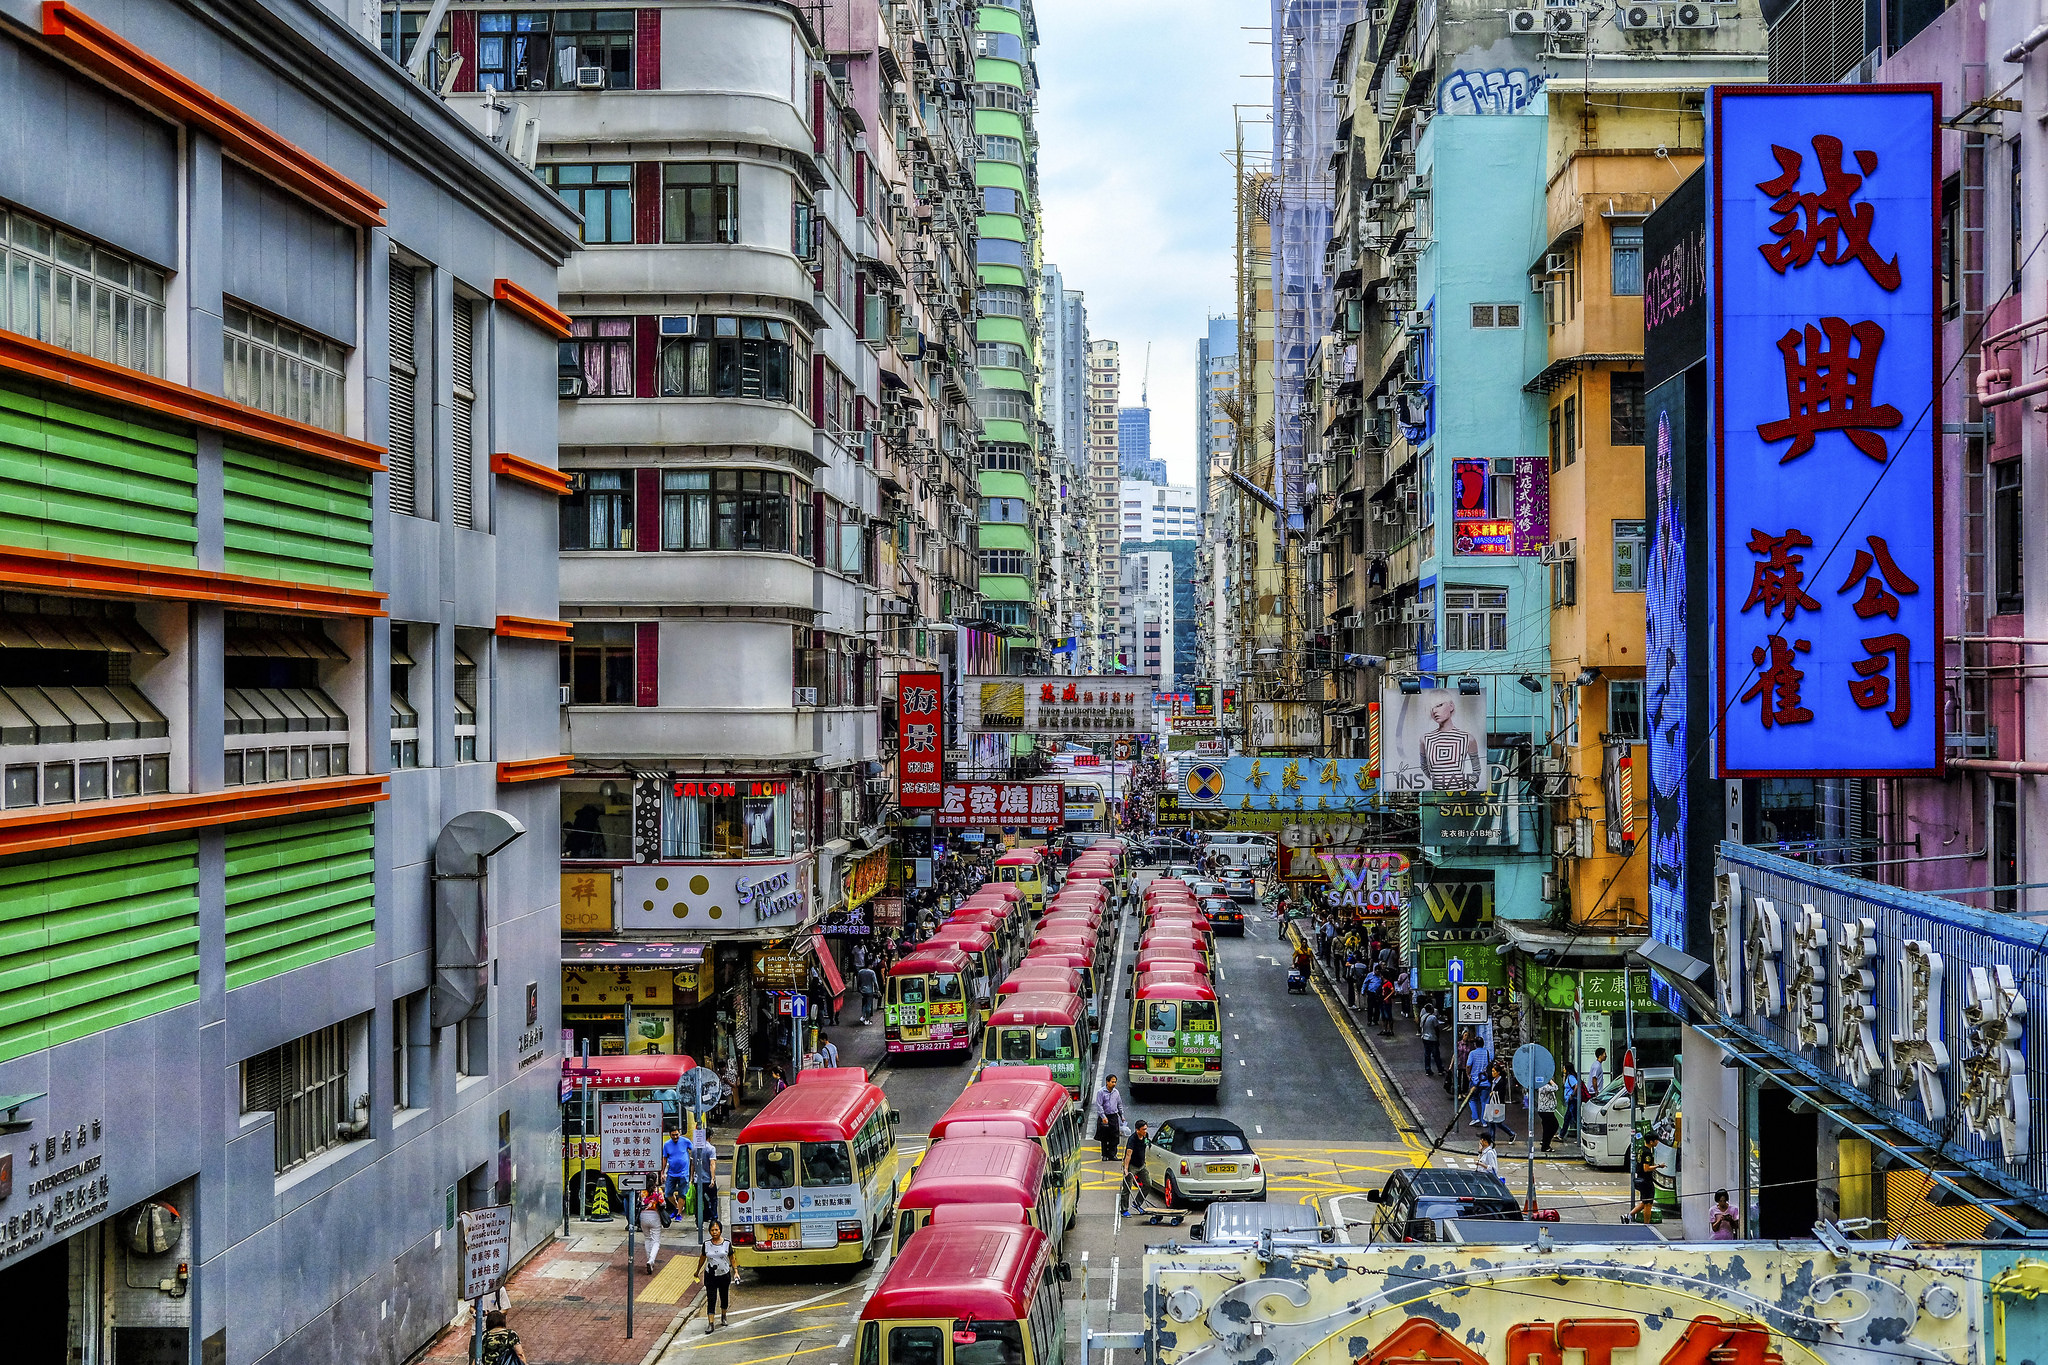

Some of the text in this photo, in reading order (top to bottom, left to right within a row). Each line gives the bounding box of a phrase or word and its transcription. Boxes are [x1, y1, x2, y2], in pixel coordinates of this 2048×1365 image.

[1756, 134, 1903, 464] 誠興
[1519, 461, 1533, 532] 酒店式裝修
[1836, 534, 1920, 729] 公司
[1038, 706, 1135, 715] Nikon Authorized Dealer
[903, 685, 938, 753] 海景
[982, 713, 1024, 726] Nikon
[1395, 773, 1478, 790] INS HAIR
[674, 782, 736, 797] SALON
[939, 784, 1062, 815] 宏發燒臘
[1440, 803, 1502, 817] SALON
[1317, 852, 1410, 892] WP
[571, 877, 598, 907] 祥
[736, 871, 791, 906] SALON
[1328, 889, 1401, 907] SALON
[565, 913, 600, 924] SHOP
[1588, 999, 1635, 1007] Elitecae
[1463, 1011, 1481, 1020] 全日
[916, 1043, 933, 1051] 2382
[934, 1042, 950, 1051] 2773
[571, 1076, 641, 1084] 型巴士十六座位
[619, 1105, 645, 1113] Vehicle
[634, 1112, 647, 1120] will
[612, 1119, 651, 1127] prosecuted
[632, 1127, 660, 1135] warning
[612, 1136, 652, 1146] 停車等候
[612, 1148, 652, 1158] 會被檢控
[607, 1160, 657, 1170] 而不予警告
[814, 1197, 852, 1207] 點對點集團
[475, 1212, 496, 1222] Vehicle
[486, 1220, 498, 1230] will
[498, 1219, 506, 1227] be
[471, 1228, 501, 1242] prosecuted
[466, 1236, 508, 1251] without warning
[471, 1248, 500, 1264] 停車等候
[471, 1263, 500, 1279] 會被檢控
